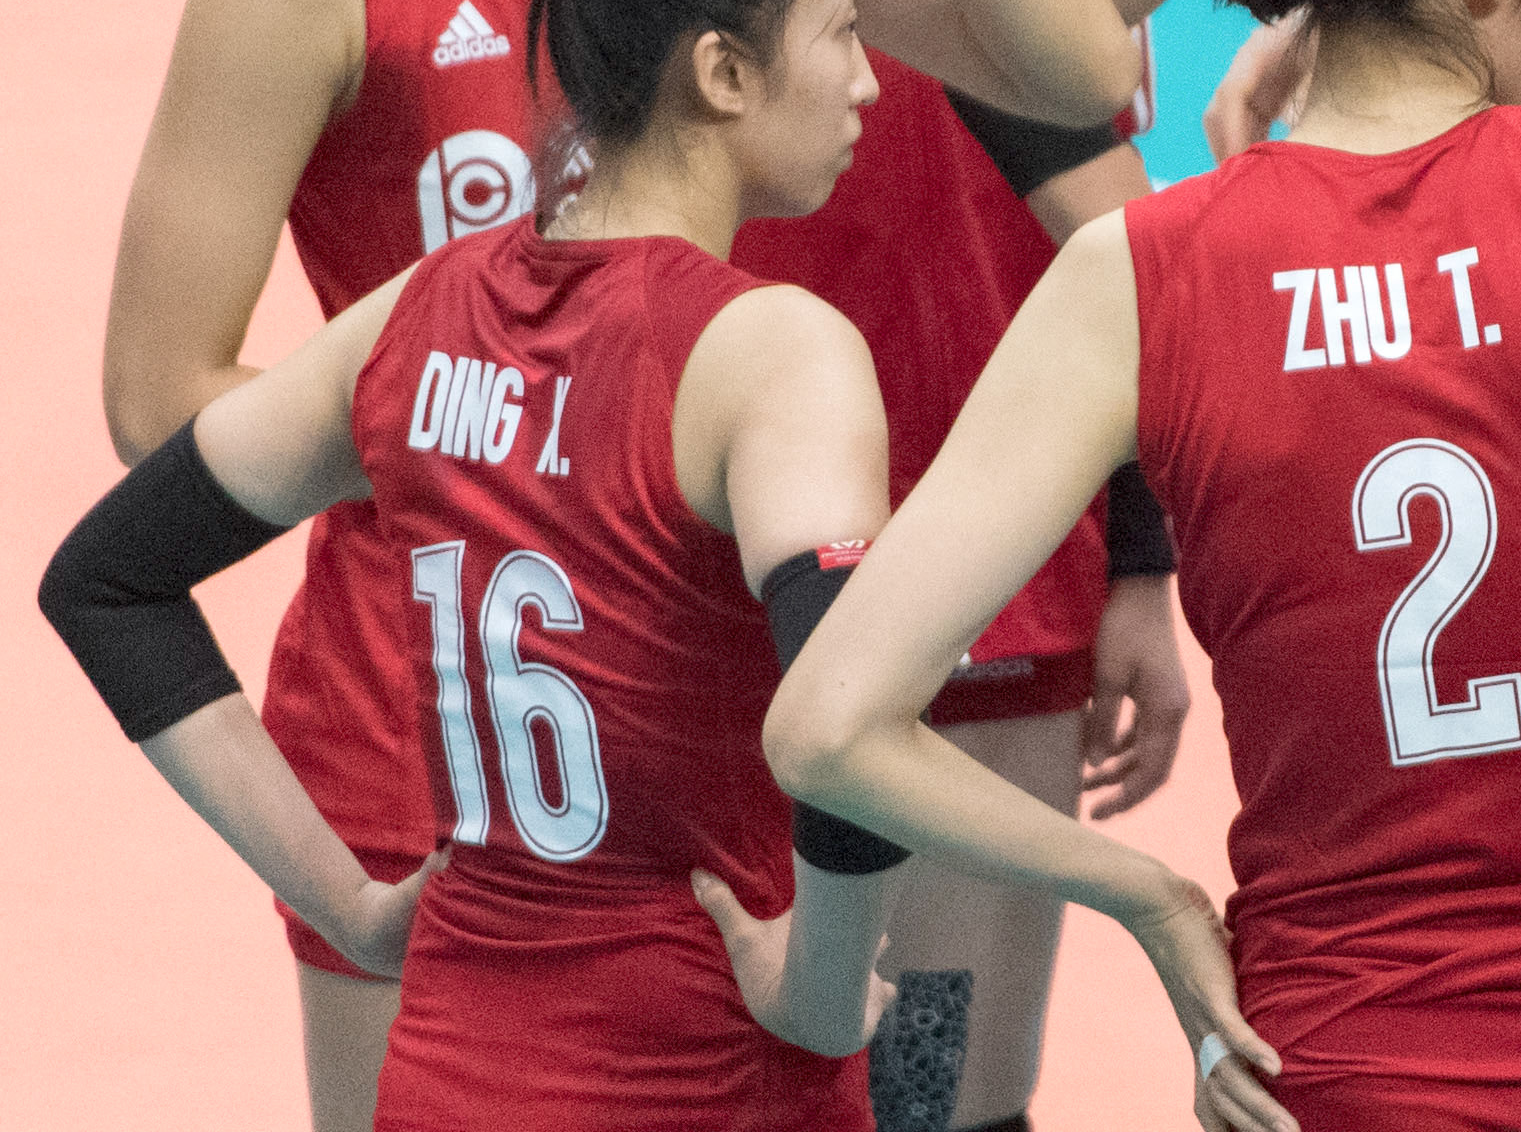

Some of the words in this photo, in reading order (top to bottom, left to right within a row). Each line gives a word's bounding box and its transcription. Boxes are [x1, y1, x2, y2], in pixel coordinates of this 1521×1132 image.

[432, 35, 512, 67] adidas
[1273, 263, 1412, 371] ZHU
[1437, 247, 1501, 349] T.
[408, 351, 525, 464] DING
[536, 374, 572, 476] X.
[411, 539, 610, 863] 16
